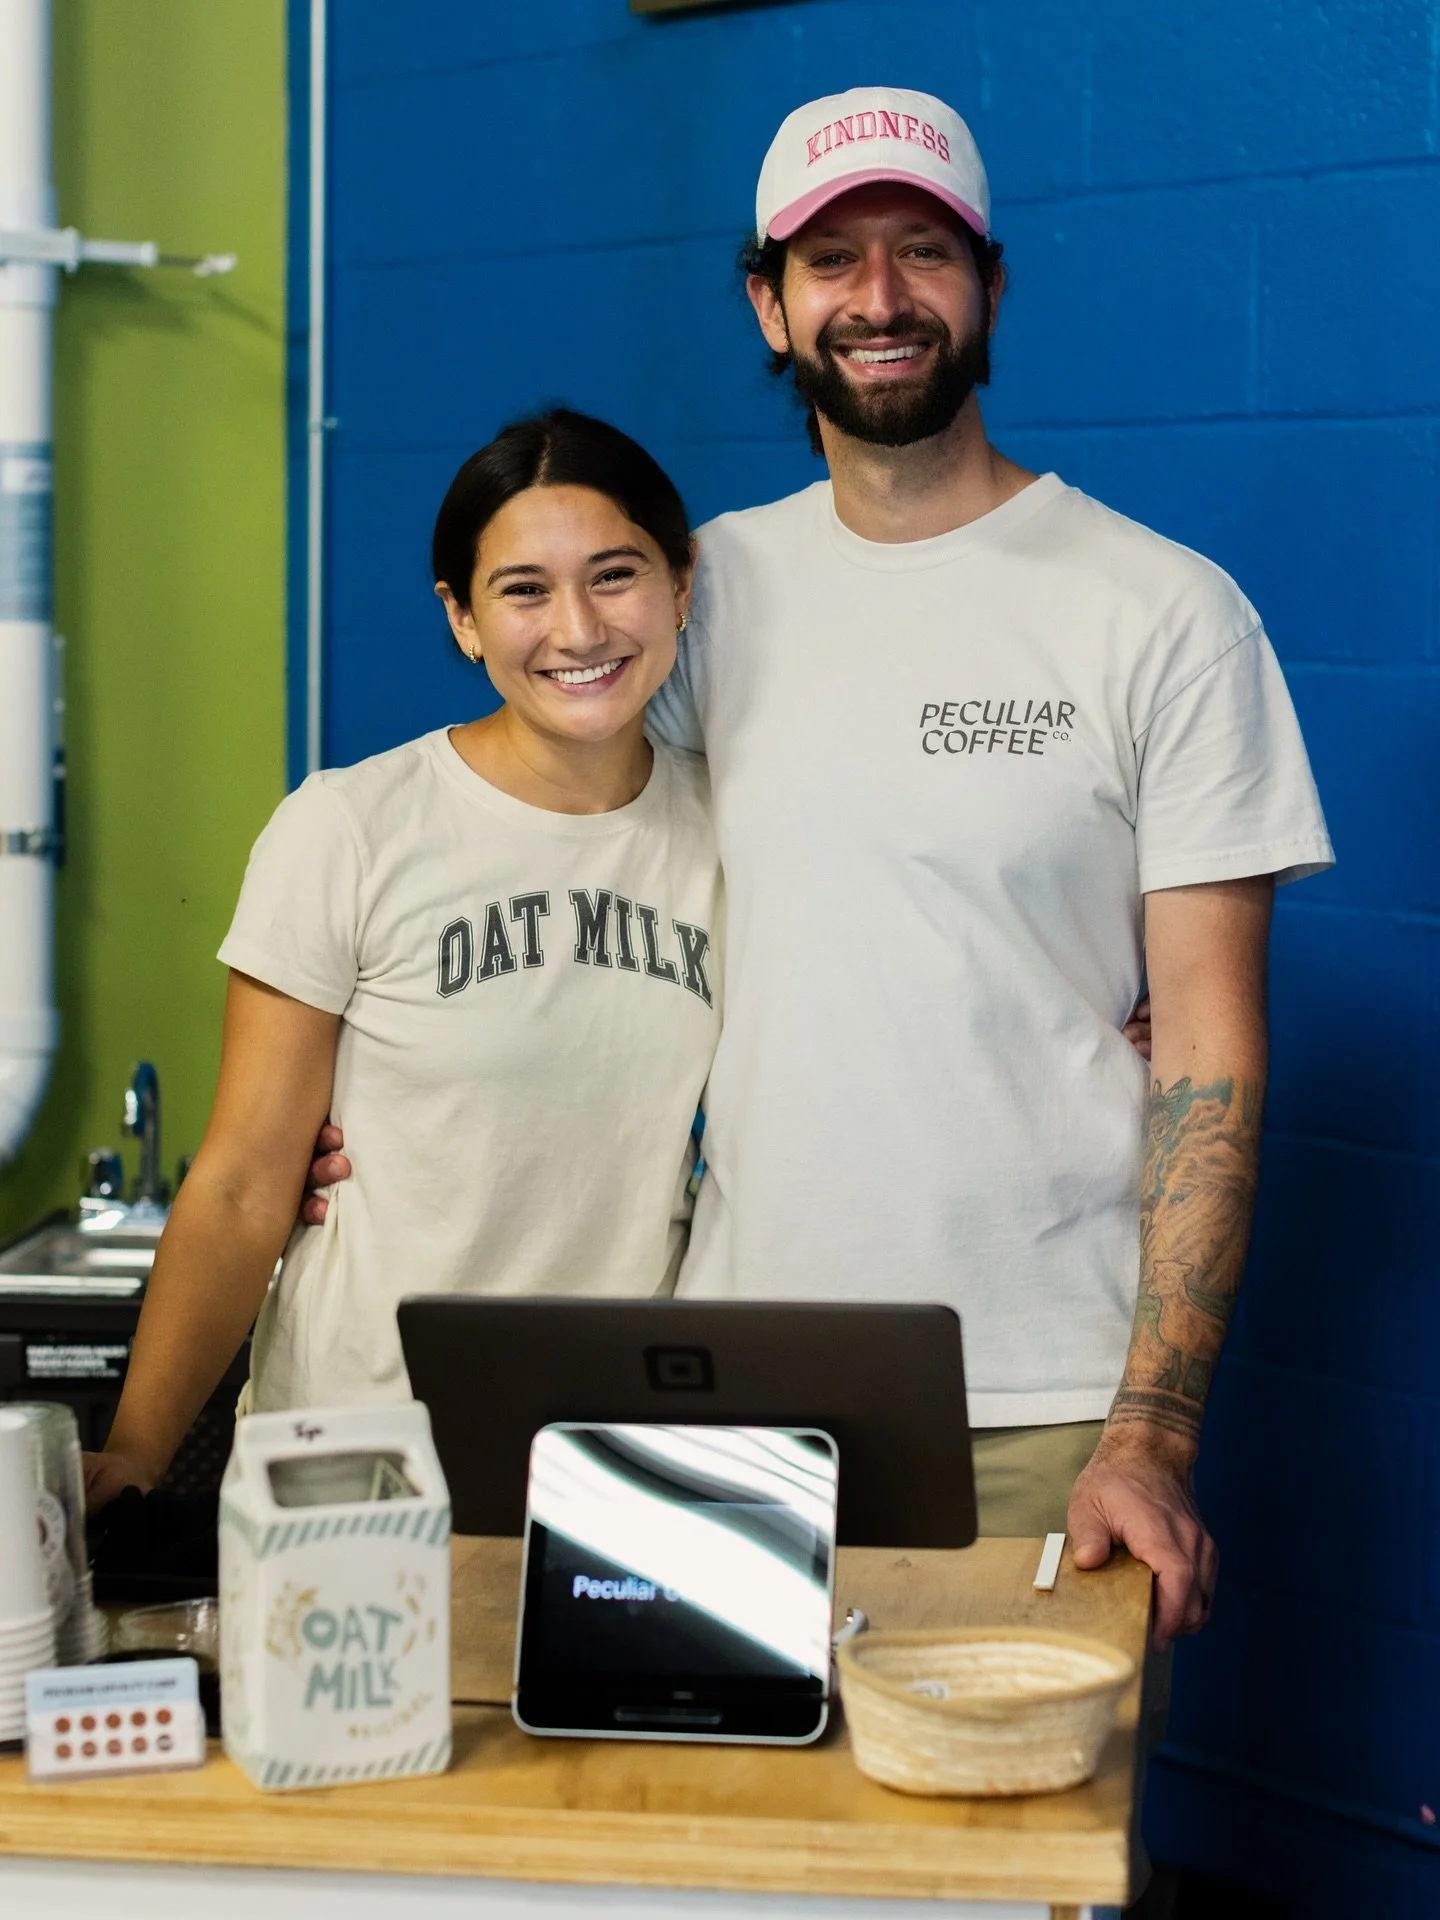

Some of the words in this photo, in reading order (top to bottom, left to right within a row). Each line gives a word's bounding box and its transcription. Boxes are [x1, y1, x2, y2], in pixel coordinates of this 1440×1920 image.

[806, 110, 951, 167] KINDNESS
[919, 699, 1076, 729] PECULIAR
[922, 728, 1048, 755] COFFEE
[1052, 730, 1072, 742] CO.
[436, 890, 551, 999] OAT
[568, 888, 713, 1010] MILK
[572, 1574, 656, 1601] Peculiar
[301, 1604, 403, 1654] OAT
[303, 1657, 402, 1711] MILK
